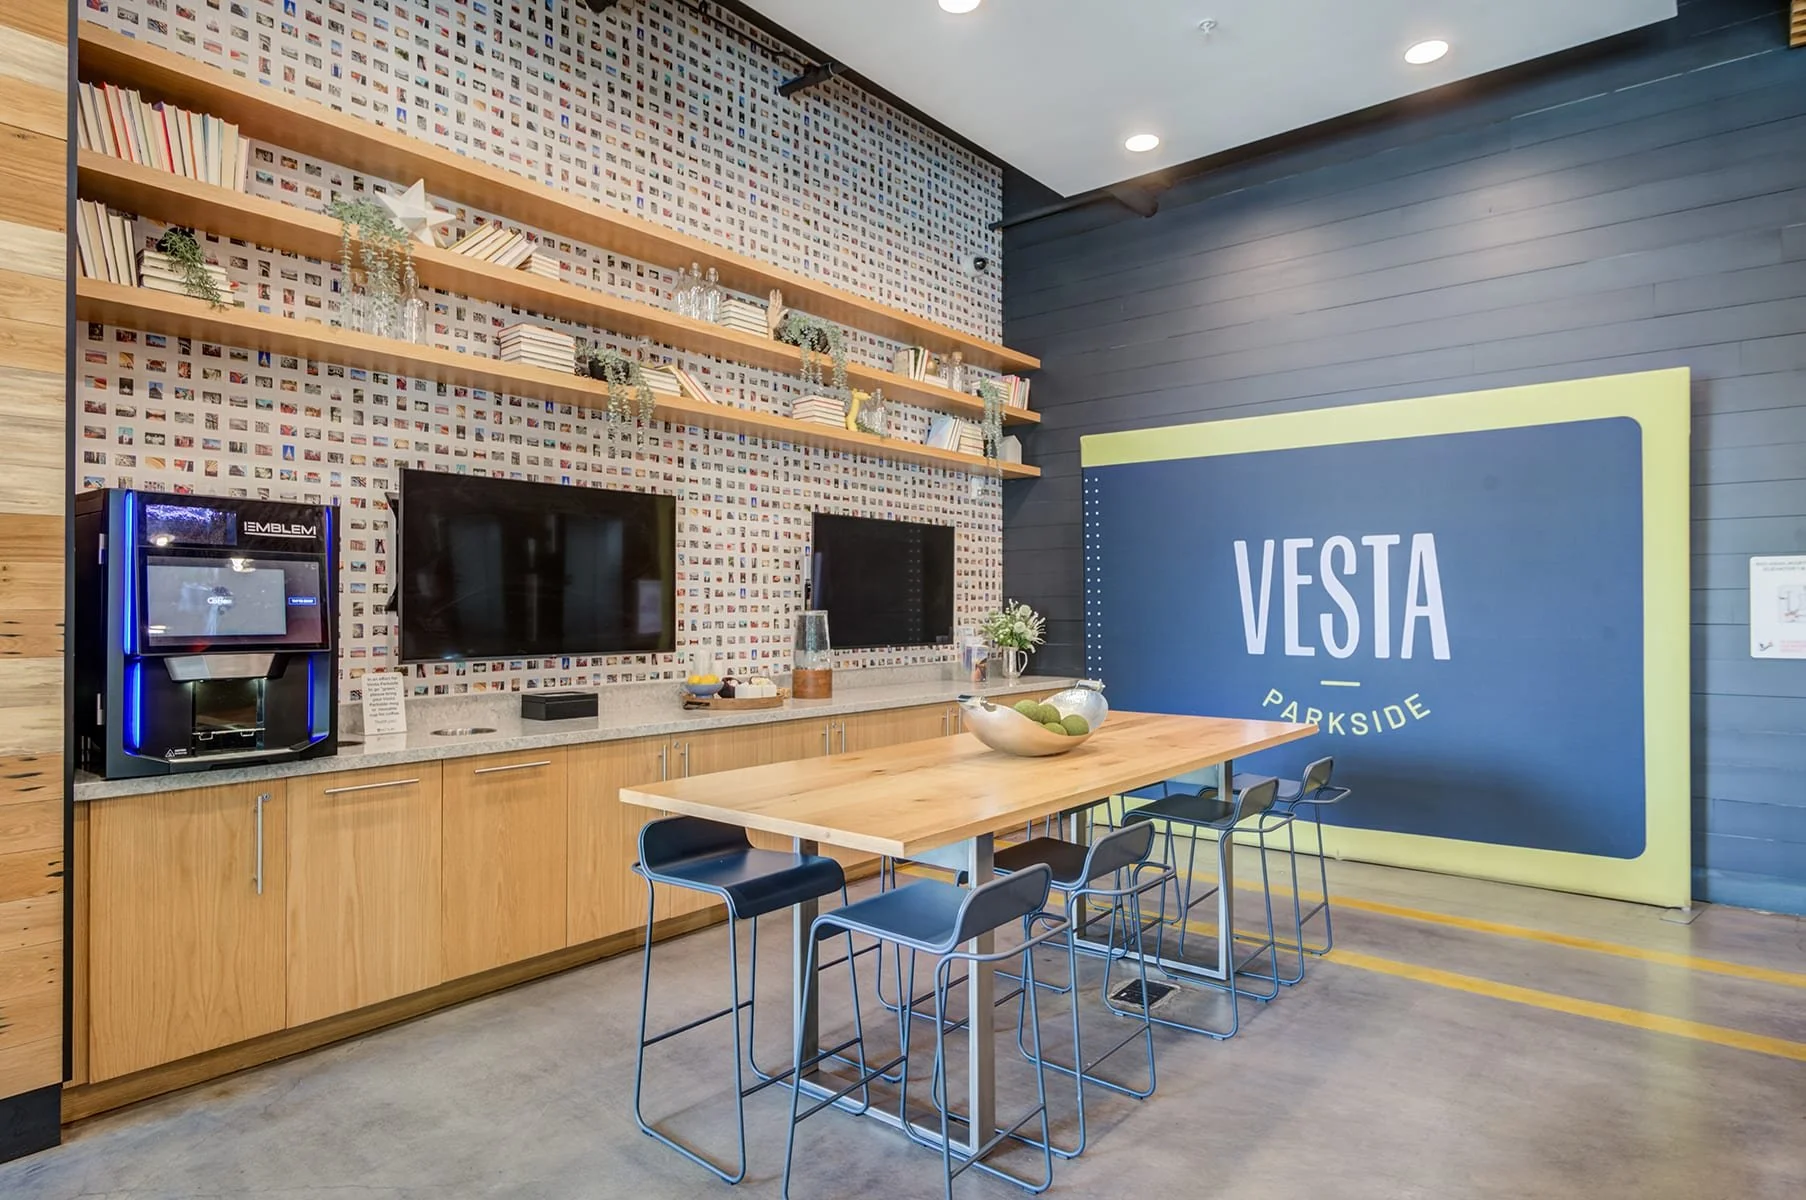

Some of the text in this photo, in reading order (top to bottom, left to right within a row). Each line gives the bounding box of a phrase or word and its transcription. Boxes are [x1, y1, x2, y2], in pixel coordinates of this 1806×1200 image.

[244, 521, 317, 535] EMBLEM
[1234, 533, 1451, 660] VESTA
[1262, 688, 1431, 735] PARKSIDE
